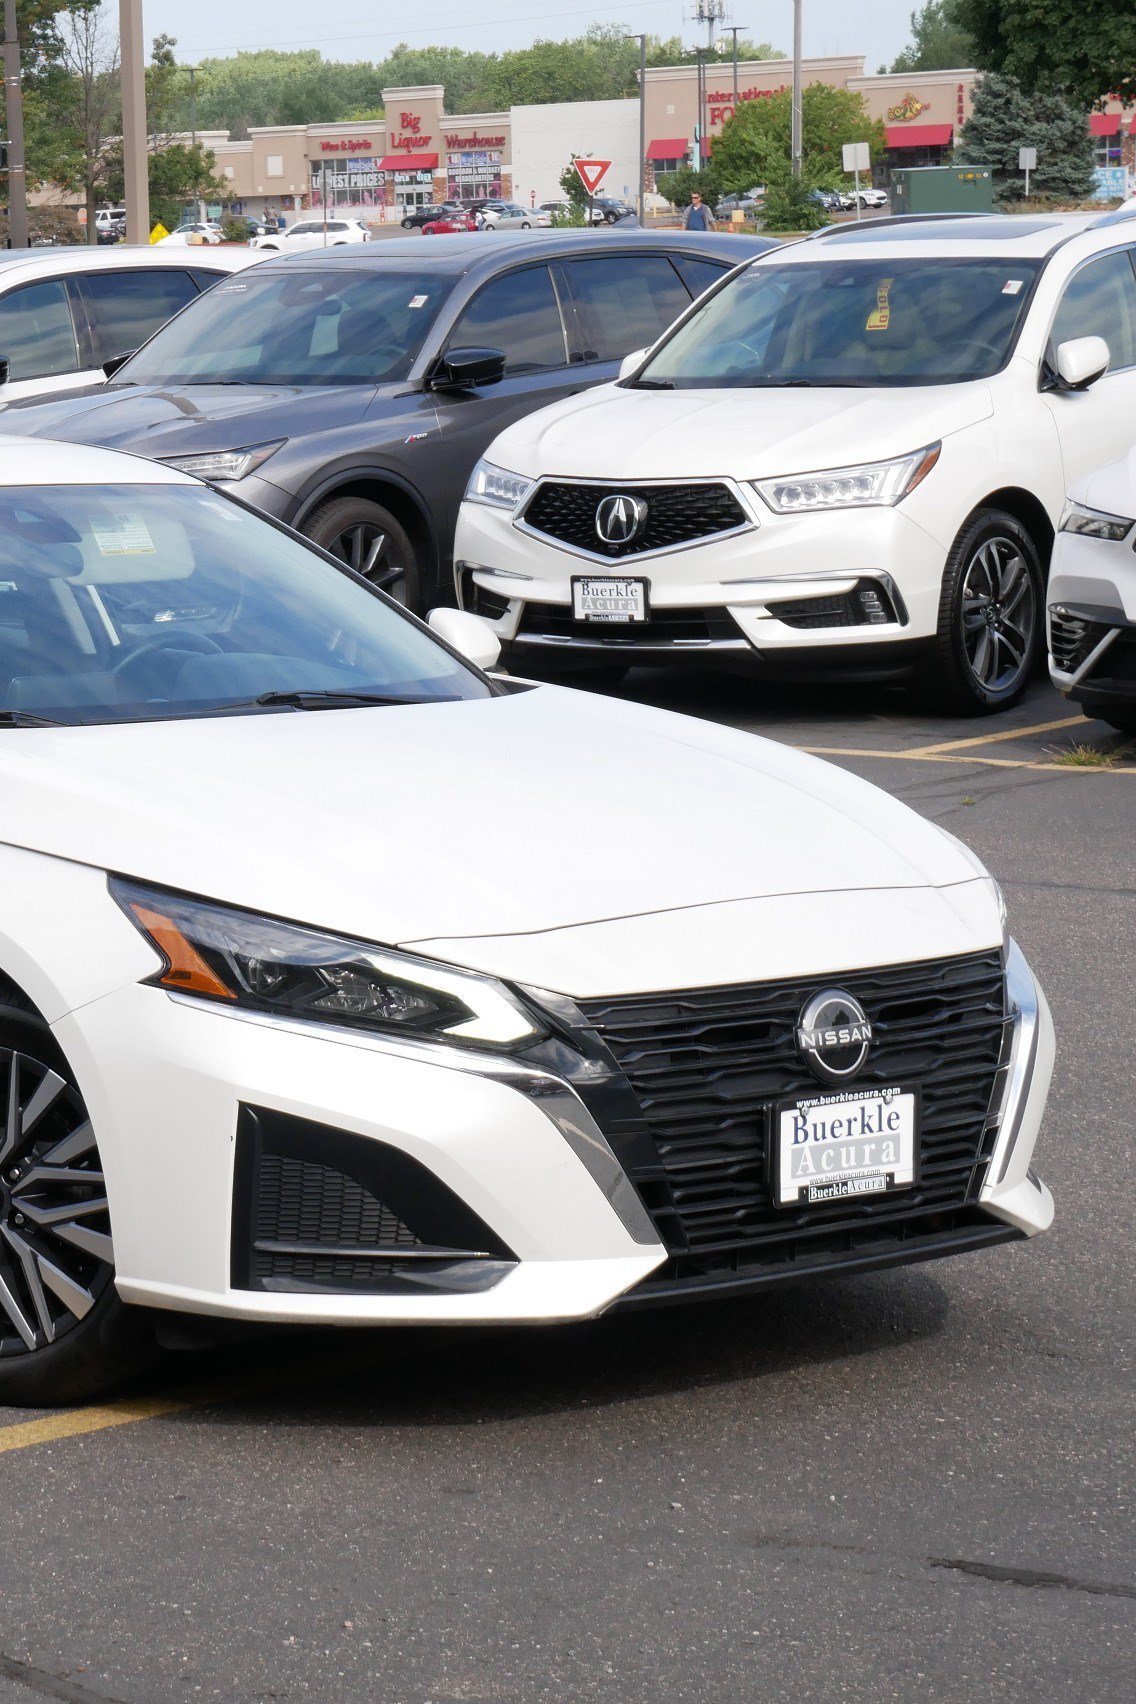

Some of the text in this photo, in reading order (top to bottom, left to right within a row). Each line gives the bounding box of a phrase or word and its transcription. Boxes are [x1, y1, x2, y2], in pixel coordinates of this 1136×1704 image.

[400, 112, 422, 134] Big
[390, 132, 433, 153] Liquor
[444, 131, 506, 149] Warehouse
[312, 173, 384, 189] LEST PRICES
[581, 583, 638, 597] Buerkle
[583, 598, 637, 610] Acura
[801, 1025, 872, 1047] NISSAN
[796, 1086, 901, 1108] www.buerkleacura.com
[790, 1103, 901, 1146] Buerkle
[795, 1138, 897, 1176] Acura
[809, 1167, 881, 1185] www.buerkleacura.com
